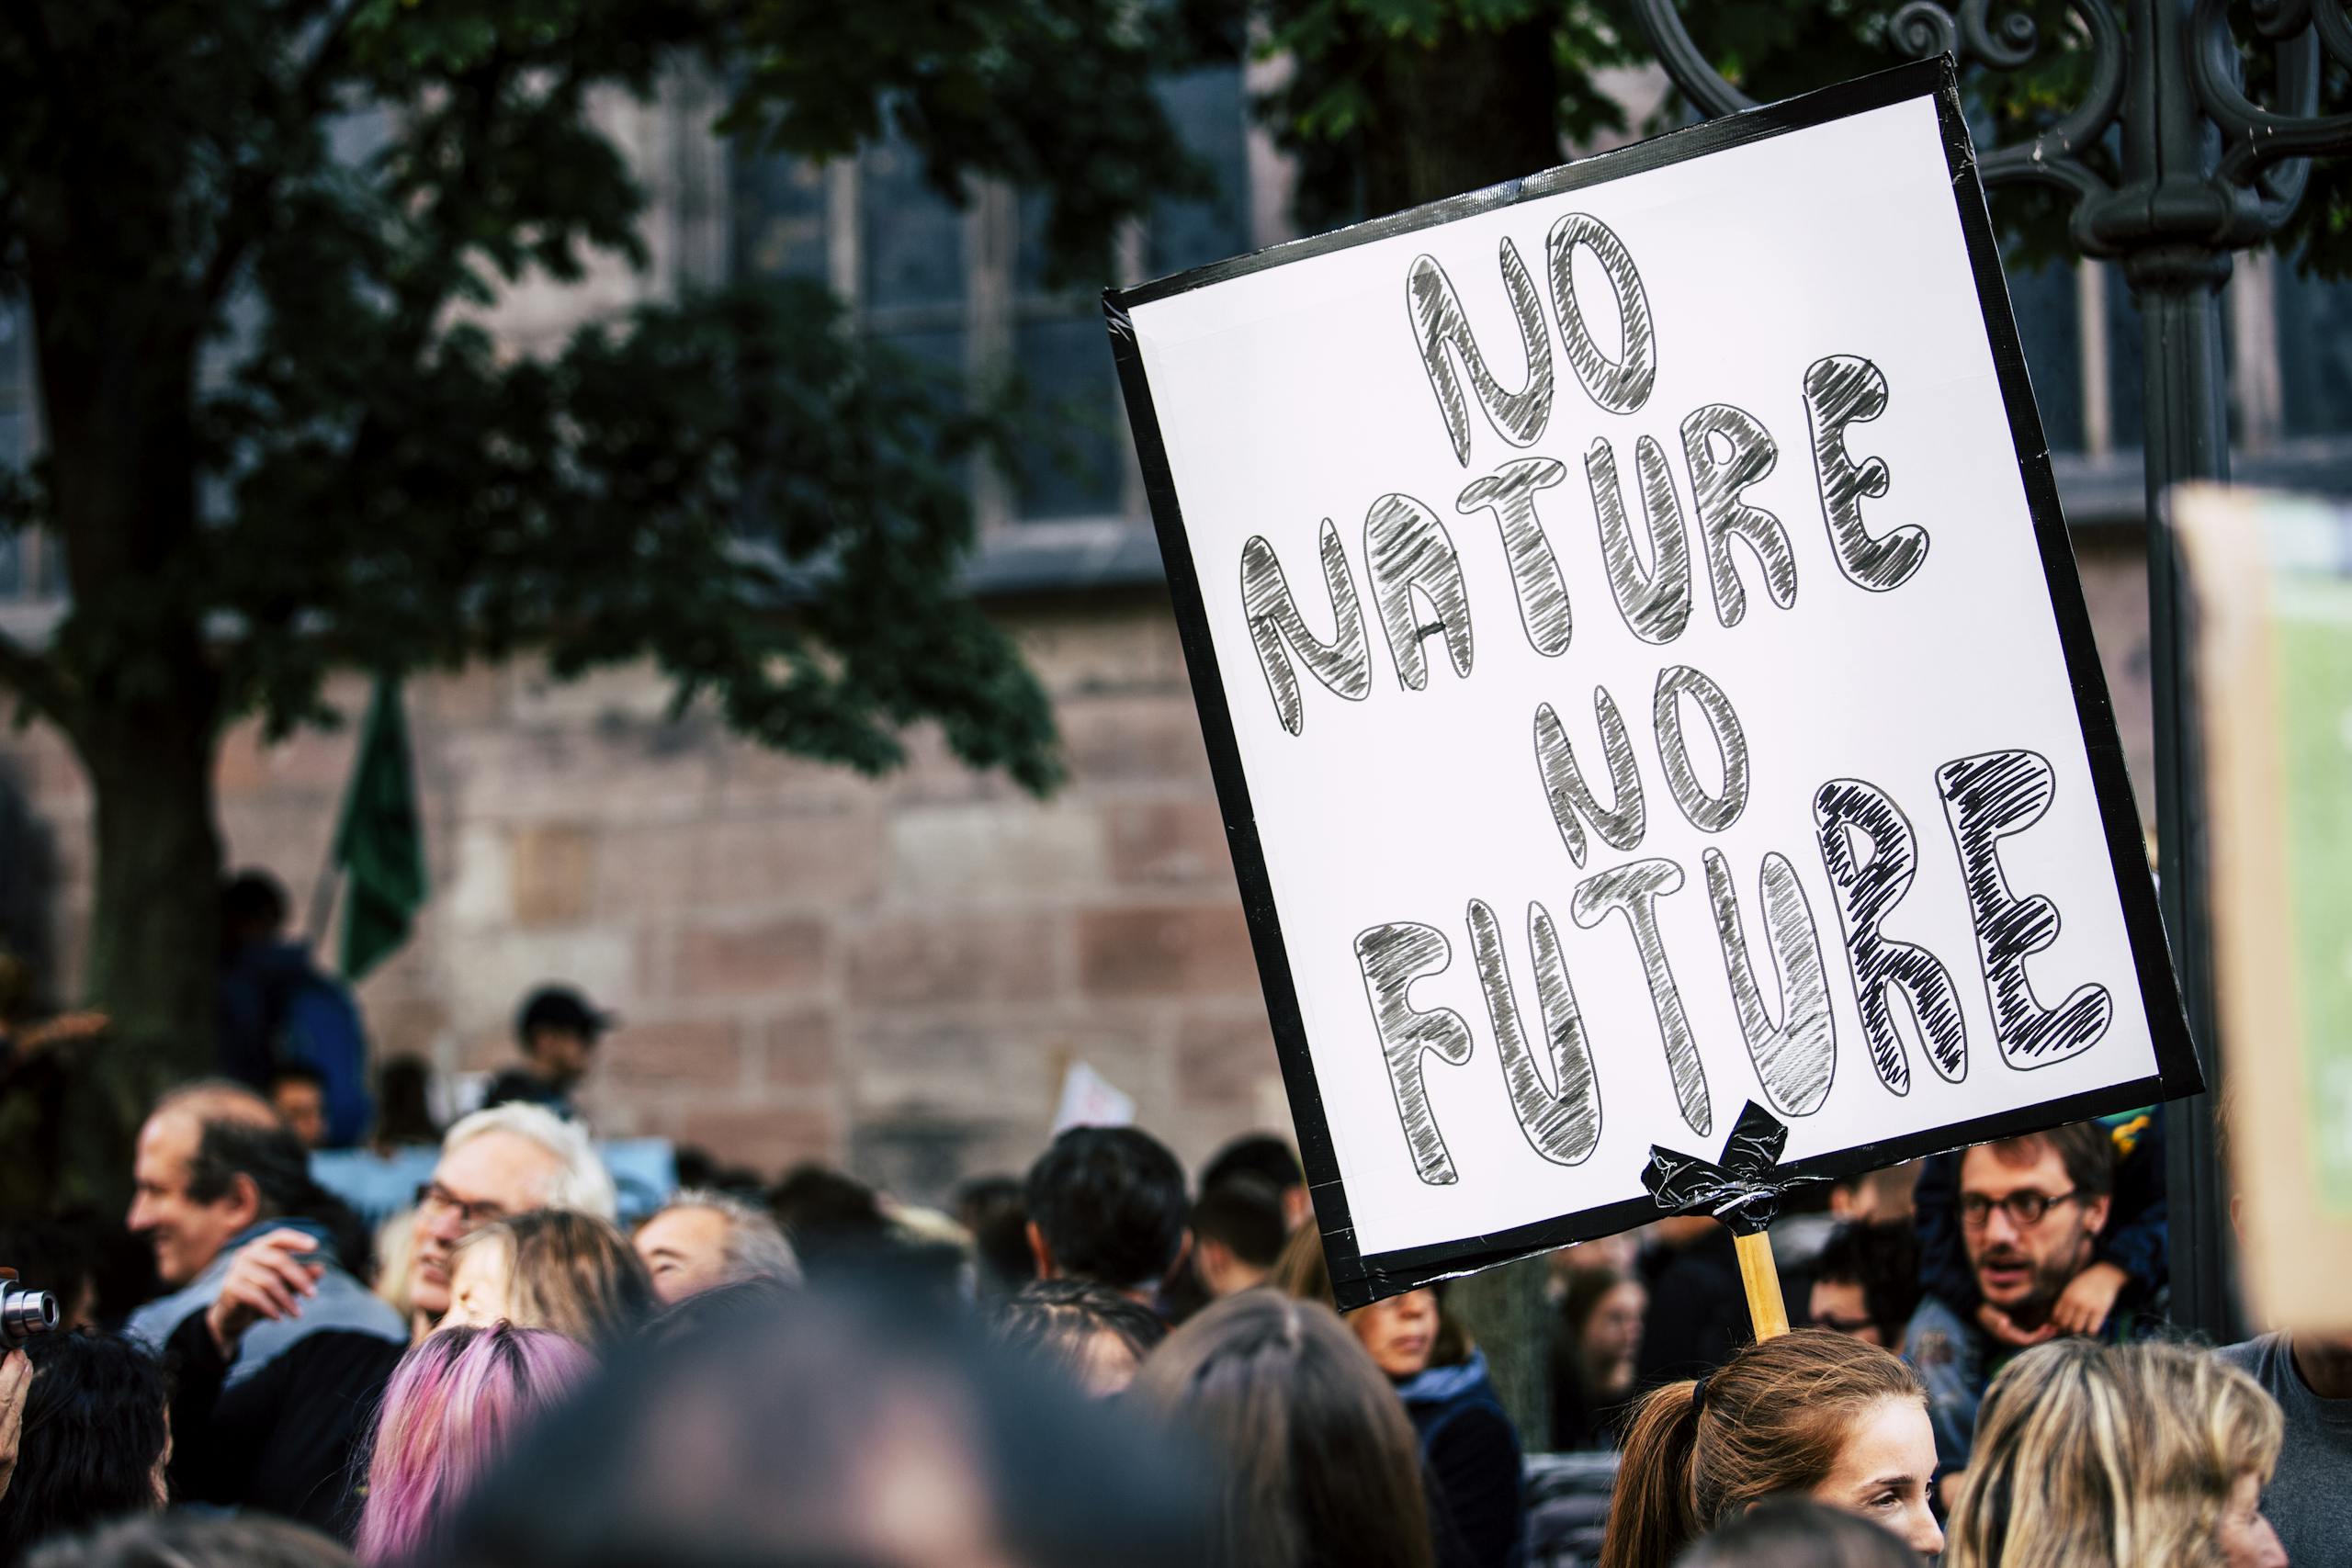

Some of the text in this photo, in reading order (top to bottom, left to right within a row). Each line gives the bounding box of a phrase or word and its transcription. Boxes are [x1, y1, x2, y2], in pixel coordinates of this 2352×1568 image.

[1406, 212, 1657, 467] NO
[1240, 355, 1930, 737] NATURE
[1534, 665, 1750, 869] NO
[1353, 749, 2113, 1186] FUTURE
